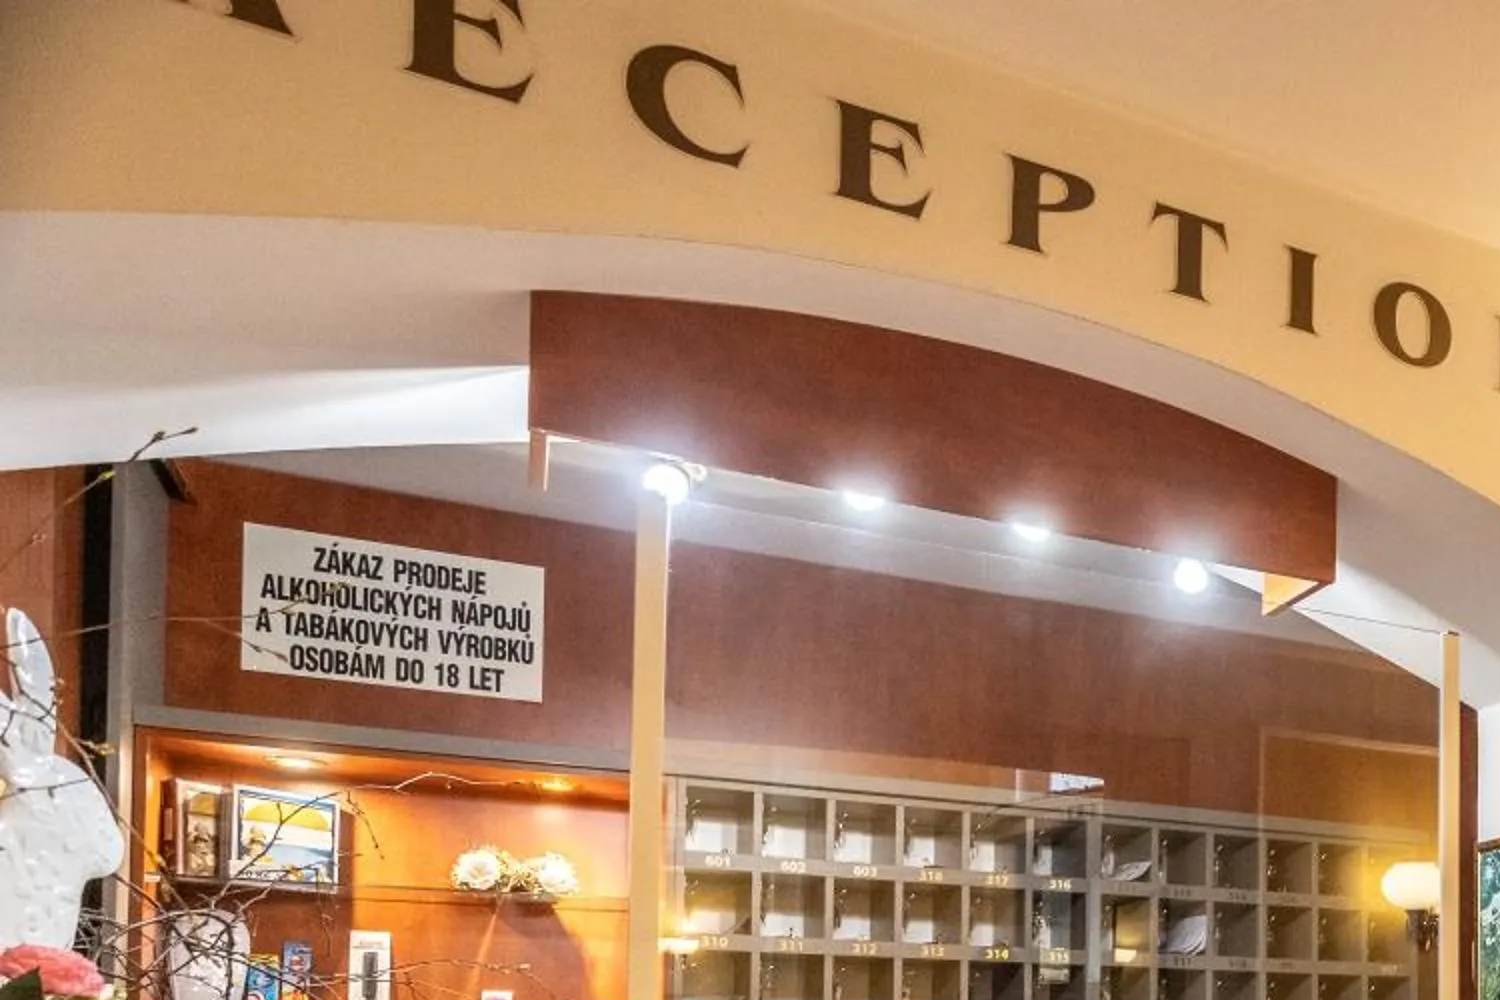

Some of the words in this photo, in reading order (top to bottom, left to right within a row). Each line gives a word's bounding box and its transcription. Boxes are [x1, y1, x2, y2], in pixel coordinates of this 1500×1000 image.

[313, 542, 384, 581] ZÁKAZ
[393, 558, 487, 596] PRODEJE
[260, 573, 442, 622] ALKOHOLICKÝCH
[451, 596, 532, 633] NÁPOJŮ
[255, 607, 272, 633] A
[283, 610, 429, 652] TABÁKOVÝCH
[437, 626, 534, 665] VÝROBKŮ
[289, 646, 385, 681] OSOBÁM
[395, 658, 425, 684] DO
[434, 664, 460, 688] 18
[469, 668, 505, 693] LET
